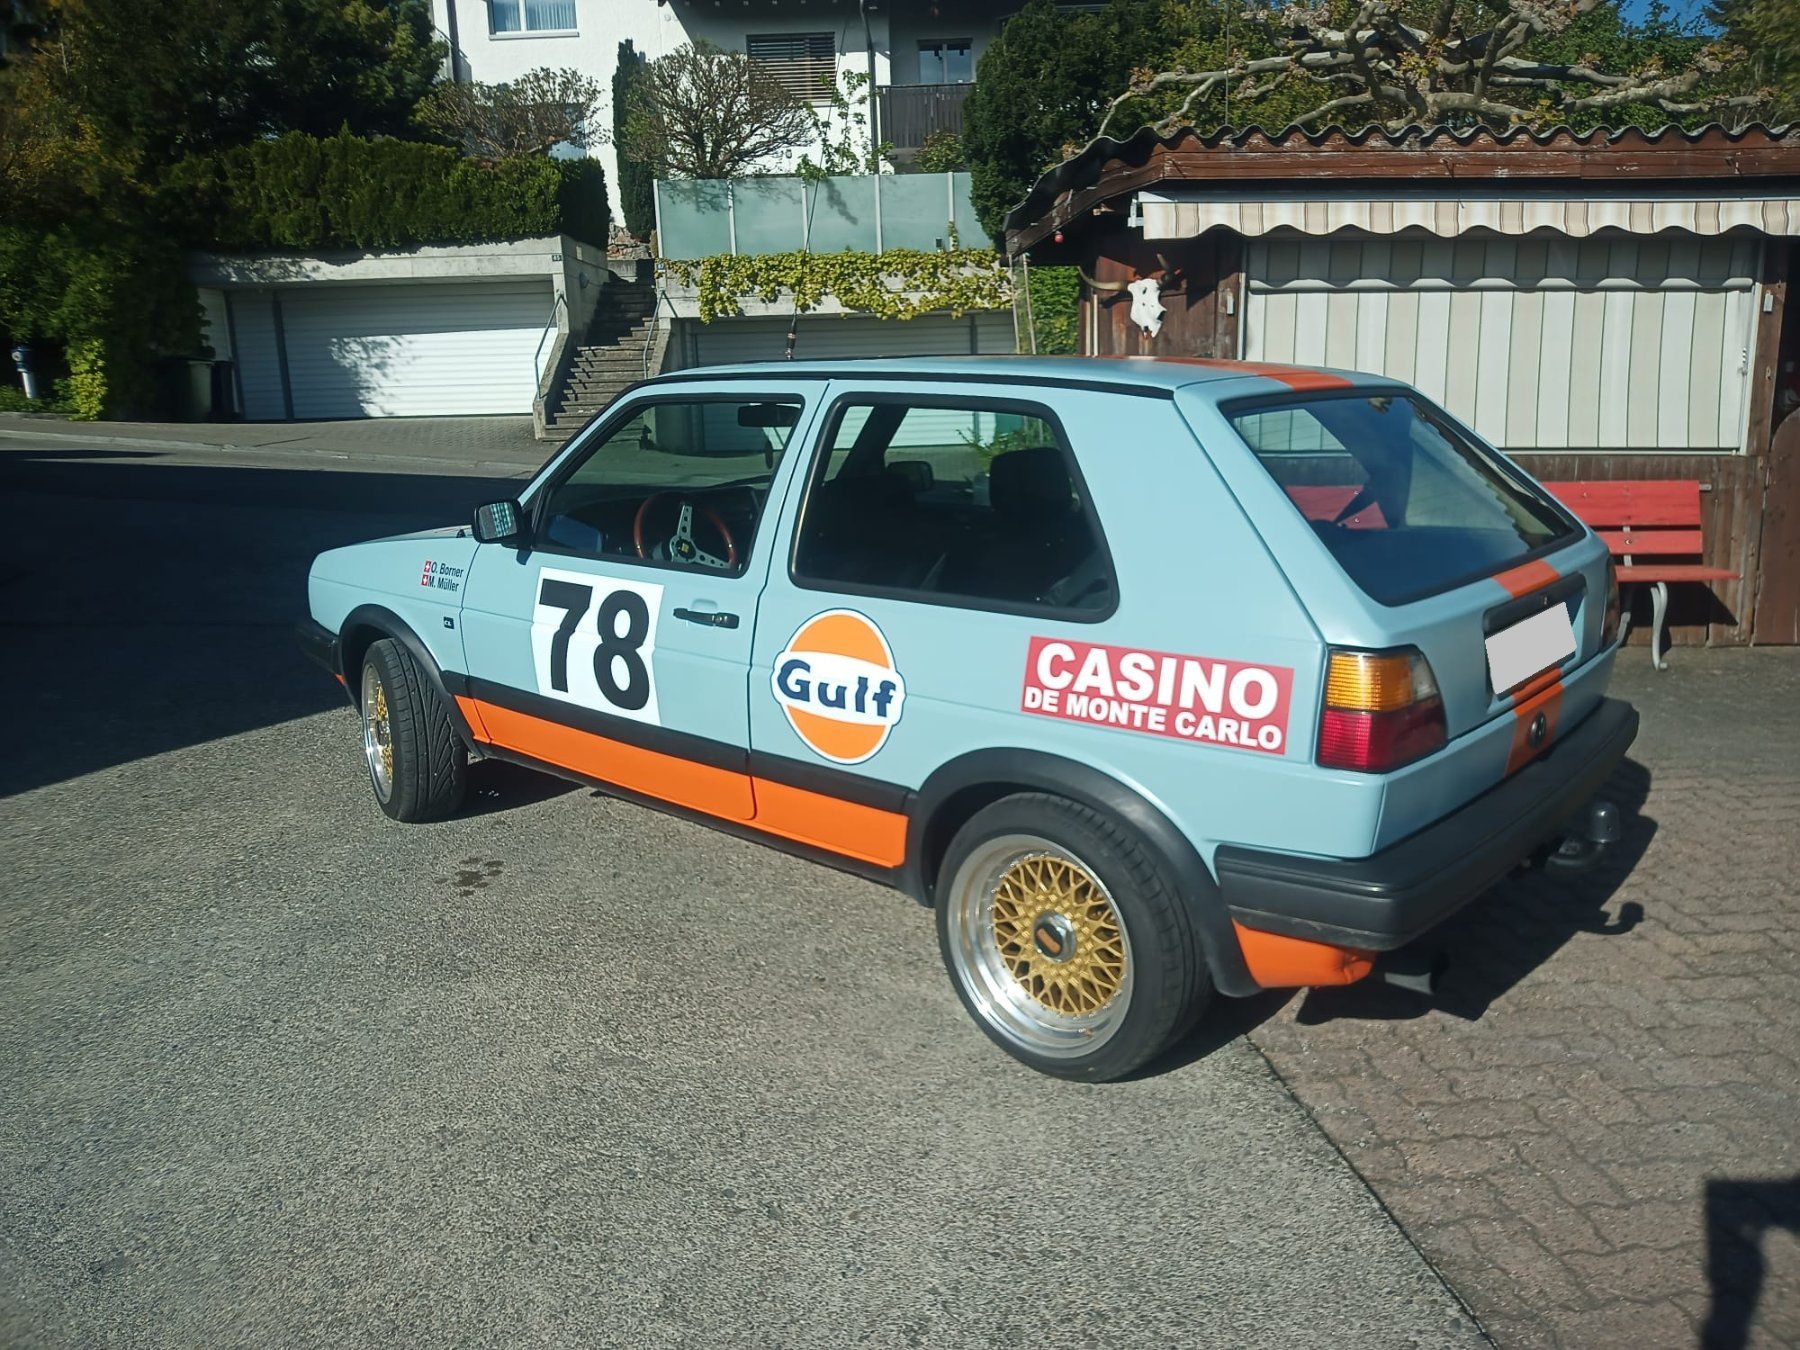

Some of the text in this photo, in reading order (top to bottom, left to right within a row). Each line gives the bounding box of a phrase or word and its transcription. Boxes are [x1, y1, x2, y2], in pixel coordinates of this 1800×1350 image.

[428, 575, 459, 592] M. Müller
[431, 561, 464, 578] O. Borner
[539, 578, 650, 711] 78
[777, 659, 896, 718] Gulf
[1036, 642, 1279, 720] CASINO
[1024, 686, 1283, 750] DE MONTE CARLO
